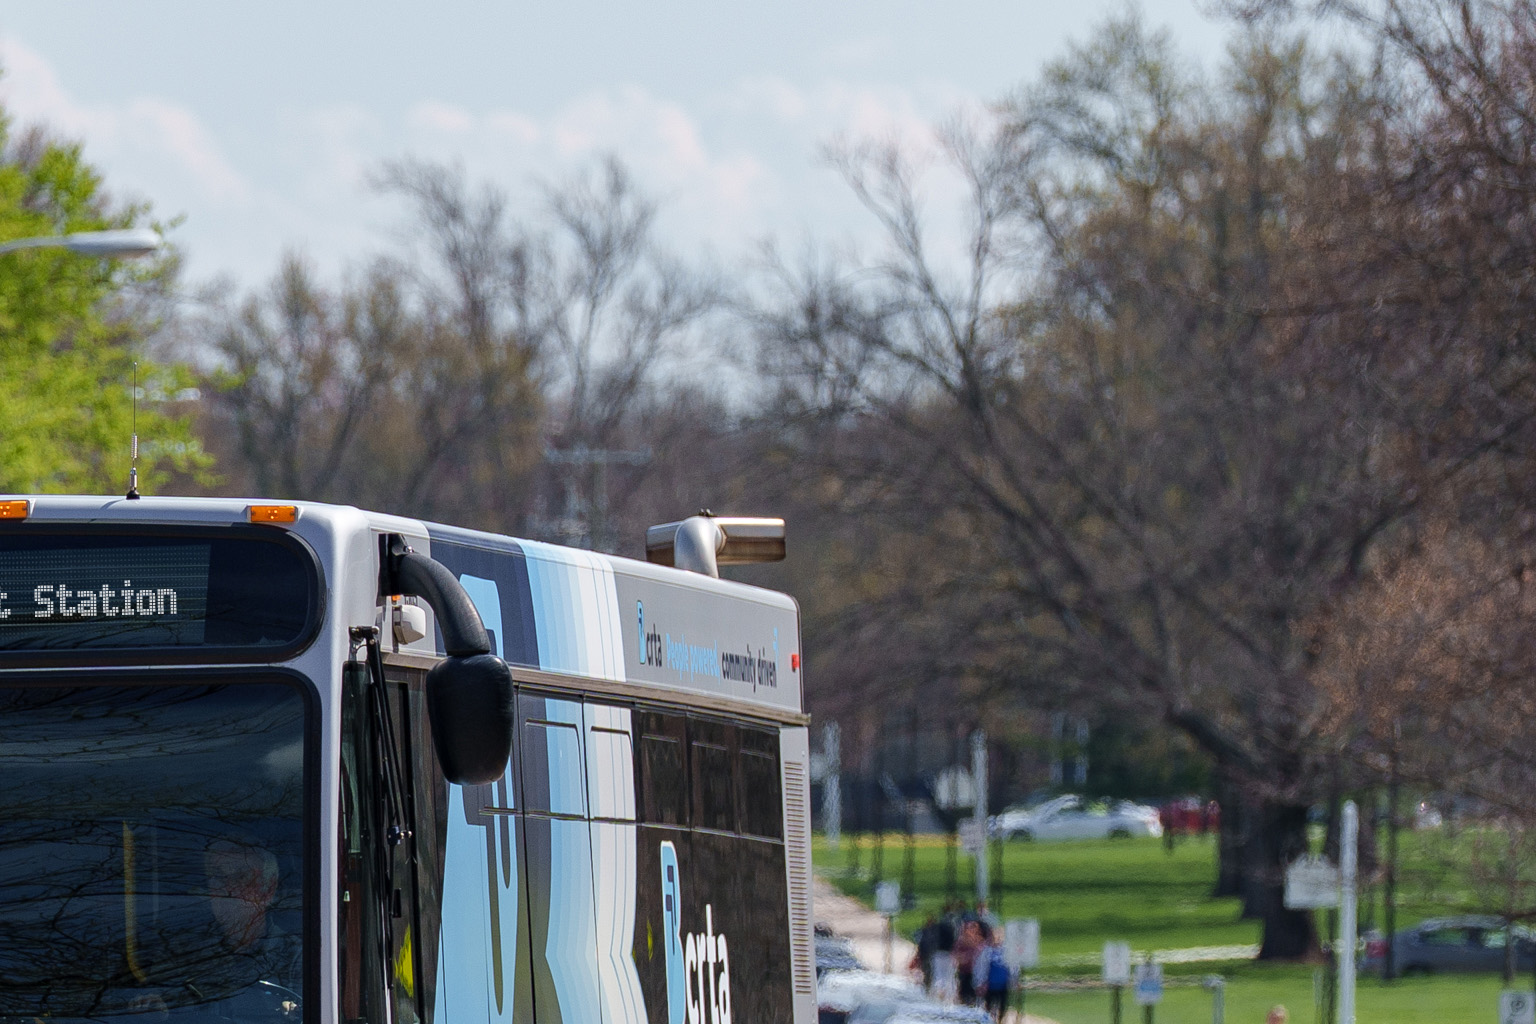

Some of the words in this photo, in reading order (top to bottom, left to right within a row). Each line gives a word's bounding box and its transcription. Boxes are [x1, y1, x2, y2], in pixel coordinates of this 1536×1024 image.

[33, 578, 179, 620] Station
[721, 643, 757, 693] community
[757, 646, 778, 689] driven
